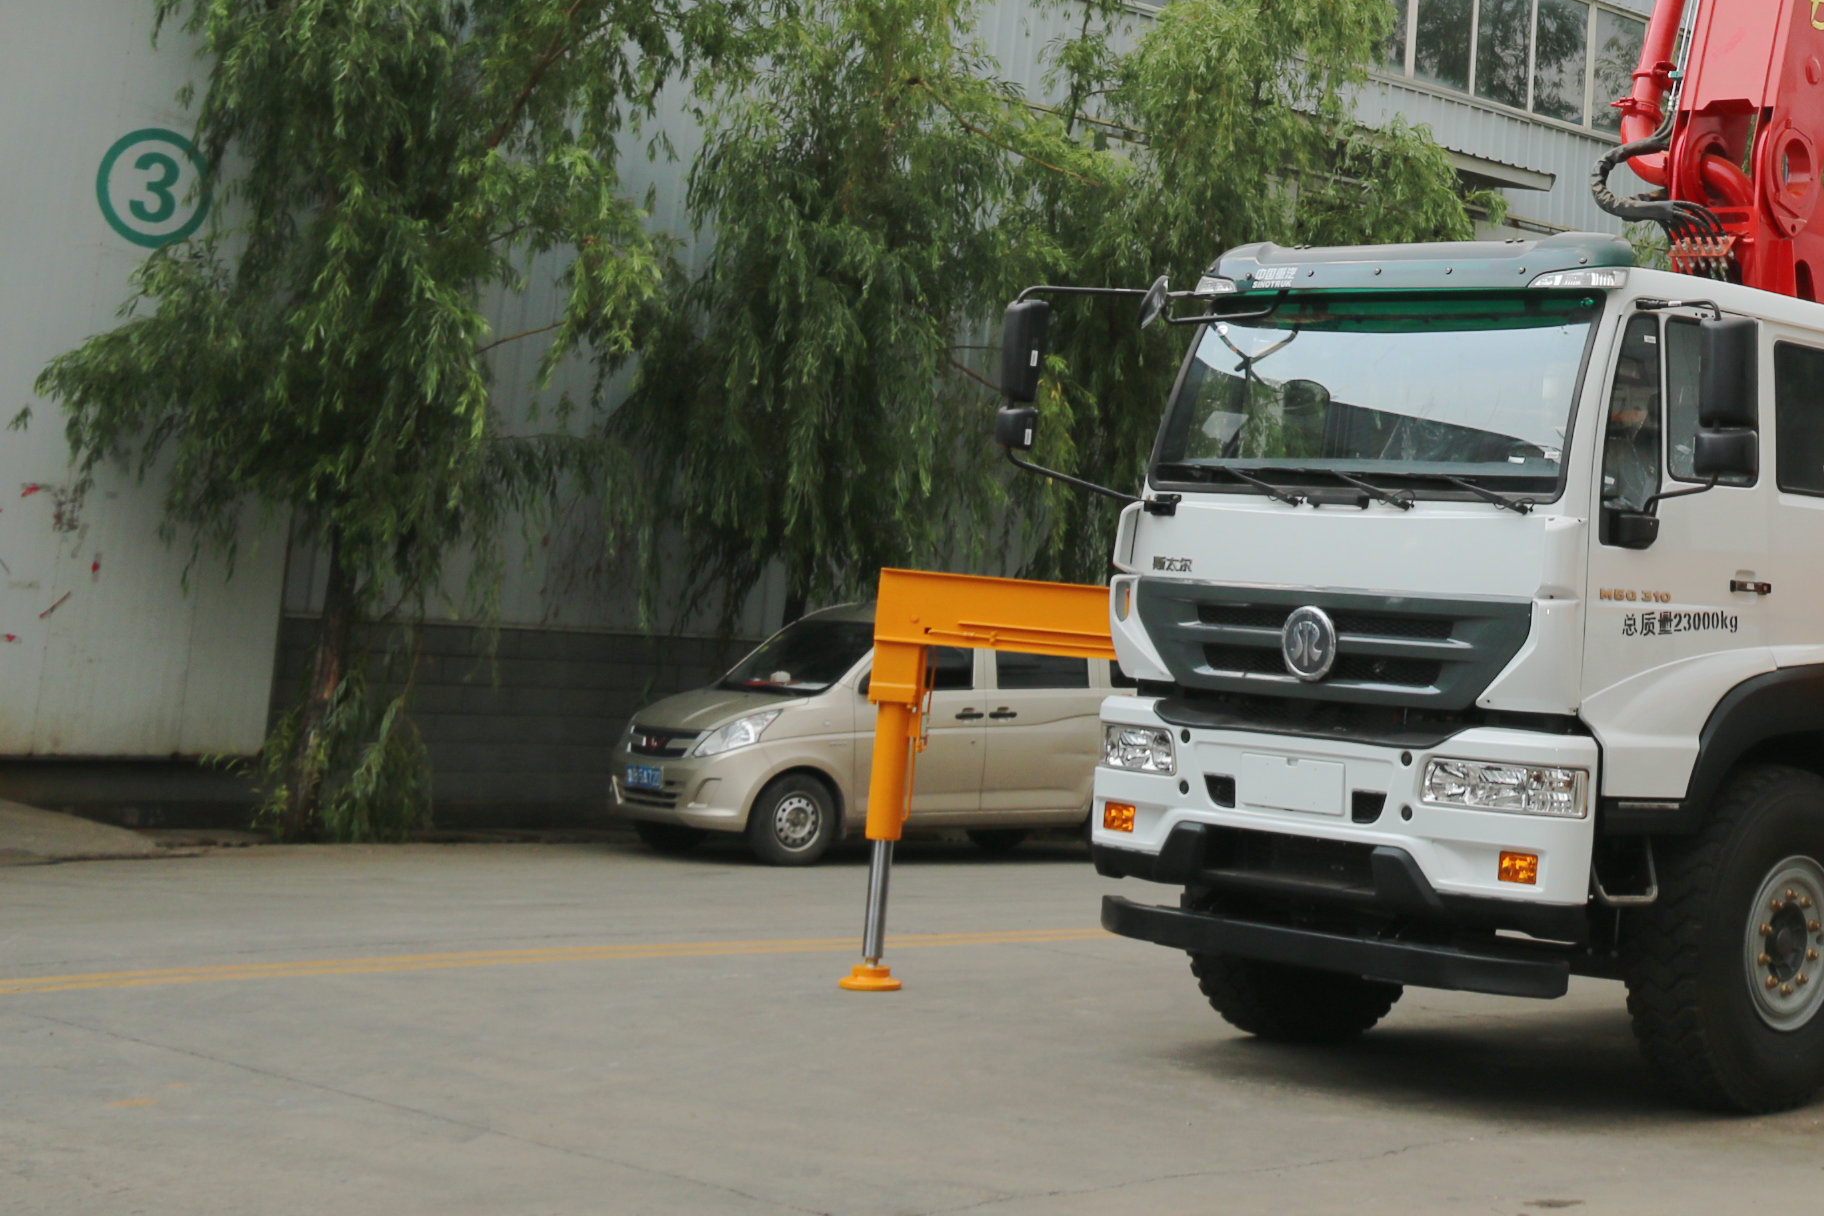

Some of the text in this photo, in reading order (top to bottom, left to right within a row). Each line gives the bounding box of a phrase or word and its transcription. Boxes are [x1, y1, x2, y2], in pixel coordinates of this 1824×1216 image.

[129, 152, 180, 223] 3
[1252, 280, 1291, 289] SINOTRUK
[1641, 590, 1671, 603] 310
